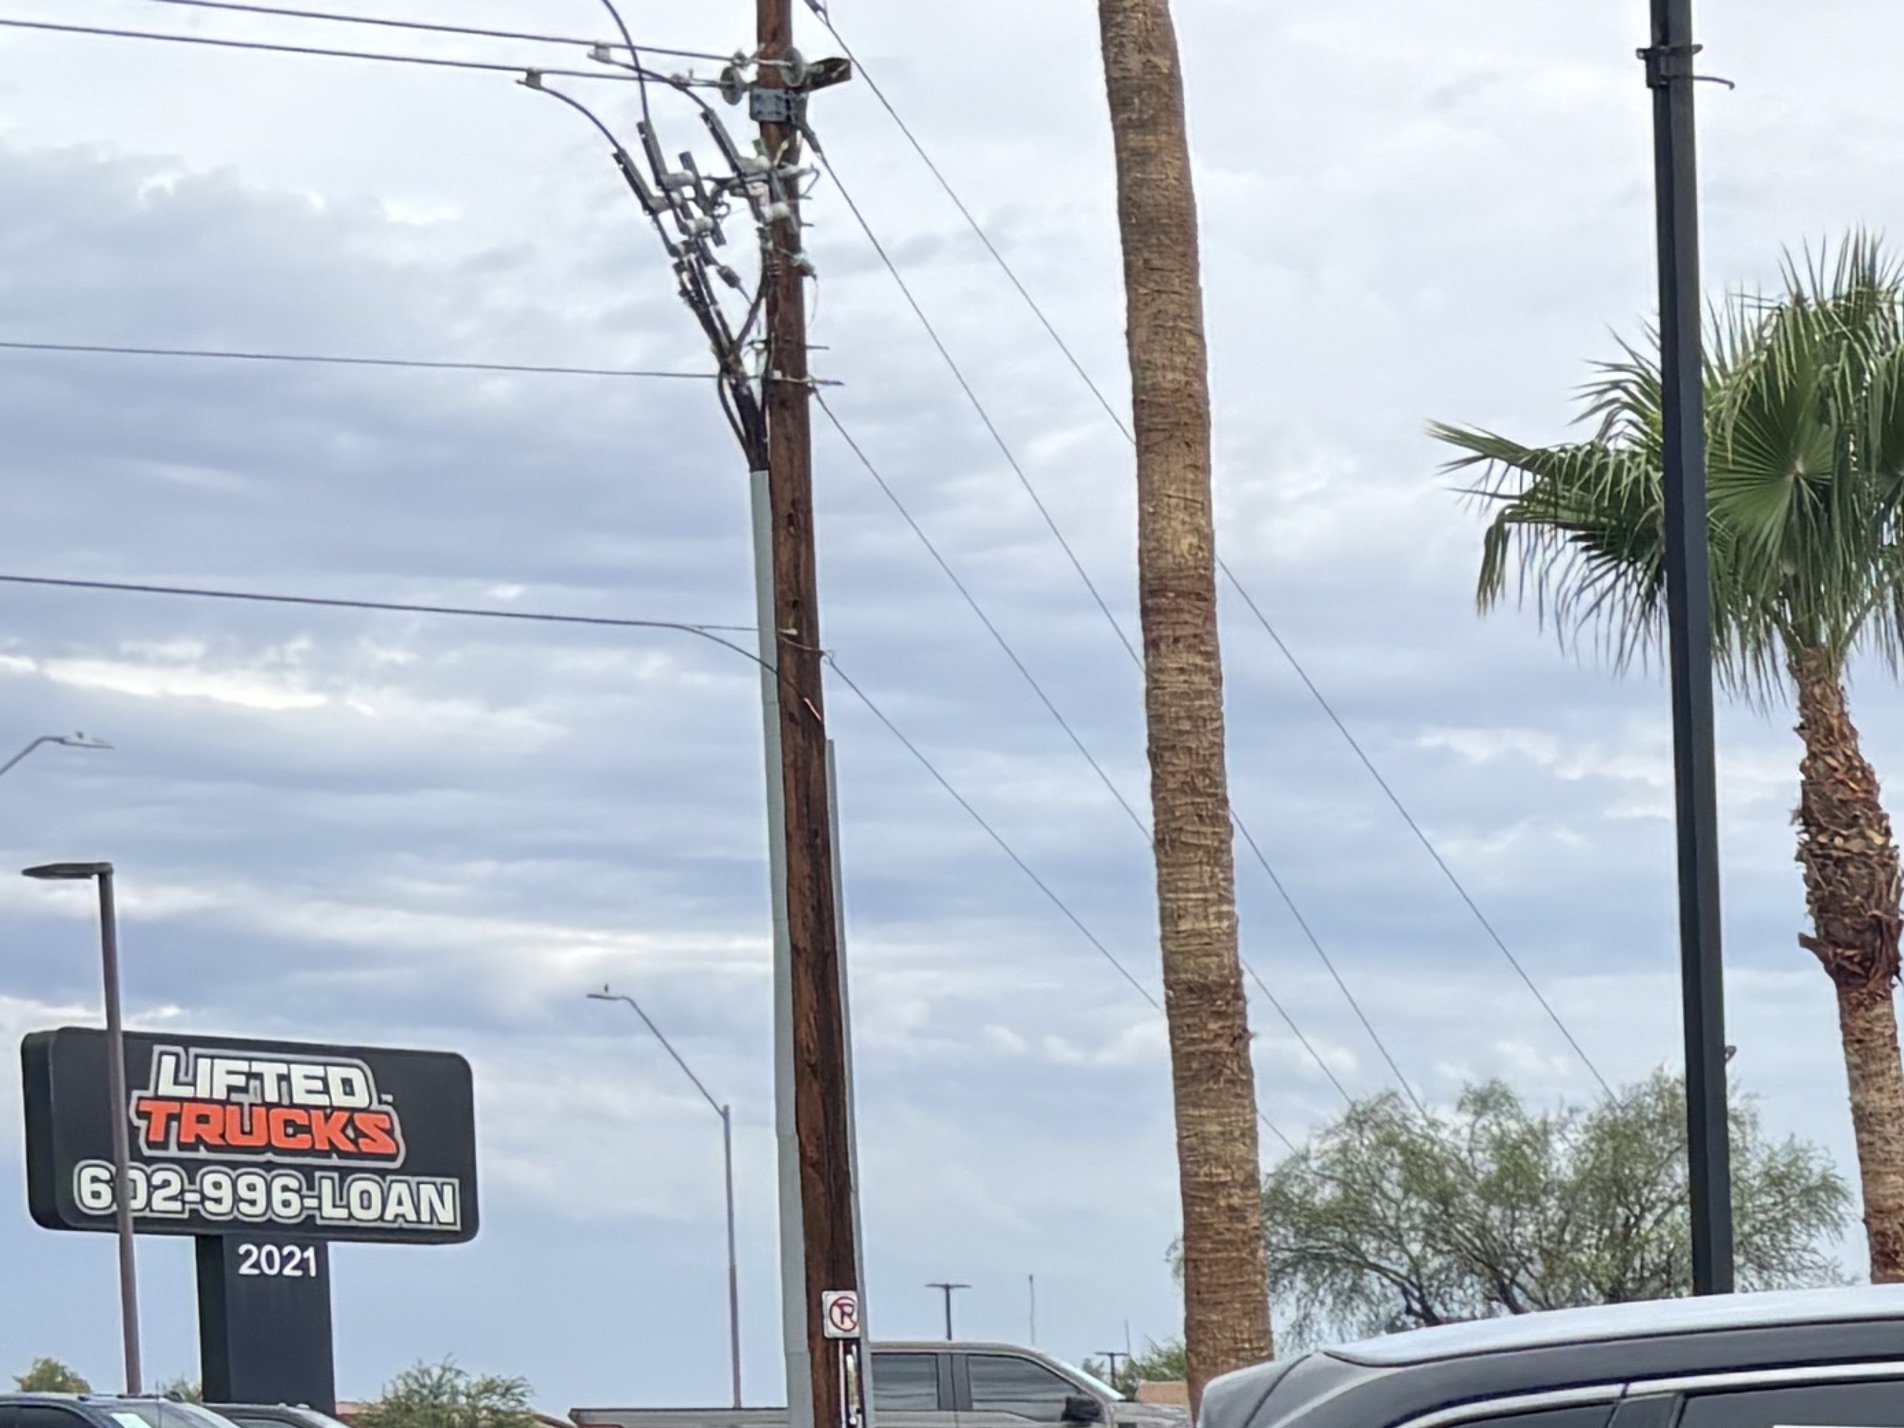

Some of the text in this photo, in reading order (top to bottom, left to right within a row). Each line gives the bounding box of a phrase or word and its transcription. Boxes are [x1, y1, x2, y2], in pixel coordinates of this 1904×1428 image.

[155, 1053, 371, 1109] LIFTED
[137, 1099, 399, 1155] TRUCKS
[78, 1166, 456, 1224] 602-996-LOAN
[237, 1243, 317, 1277] 2021
